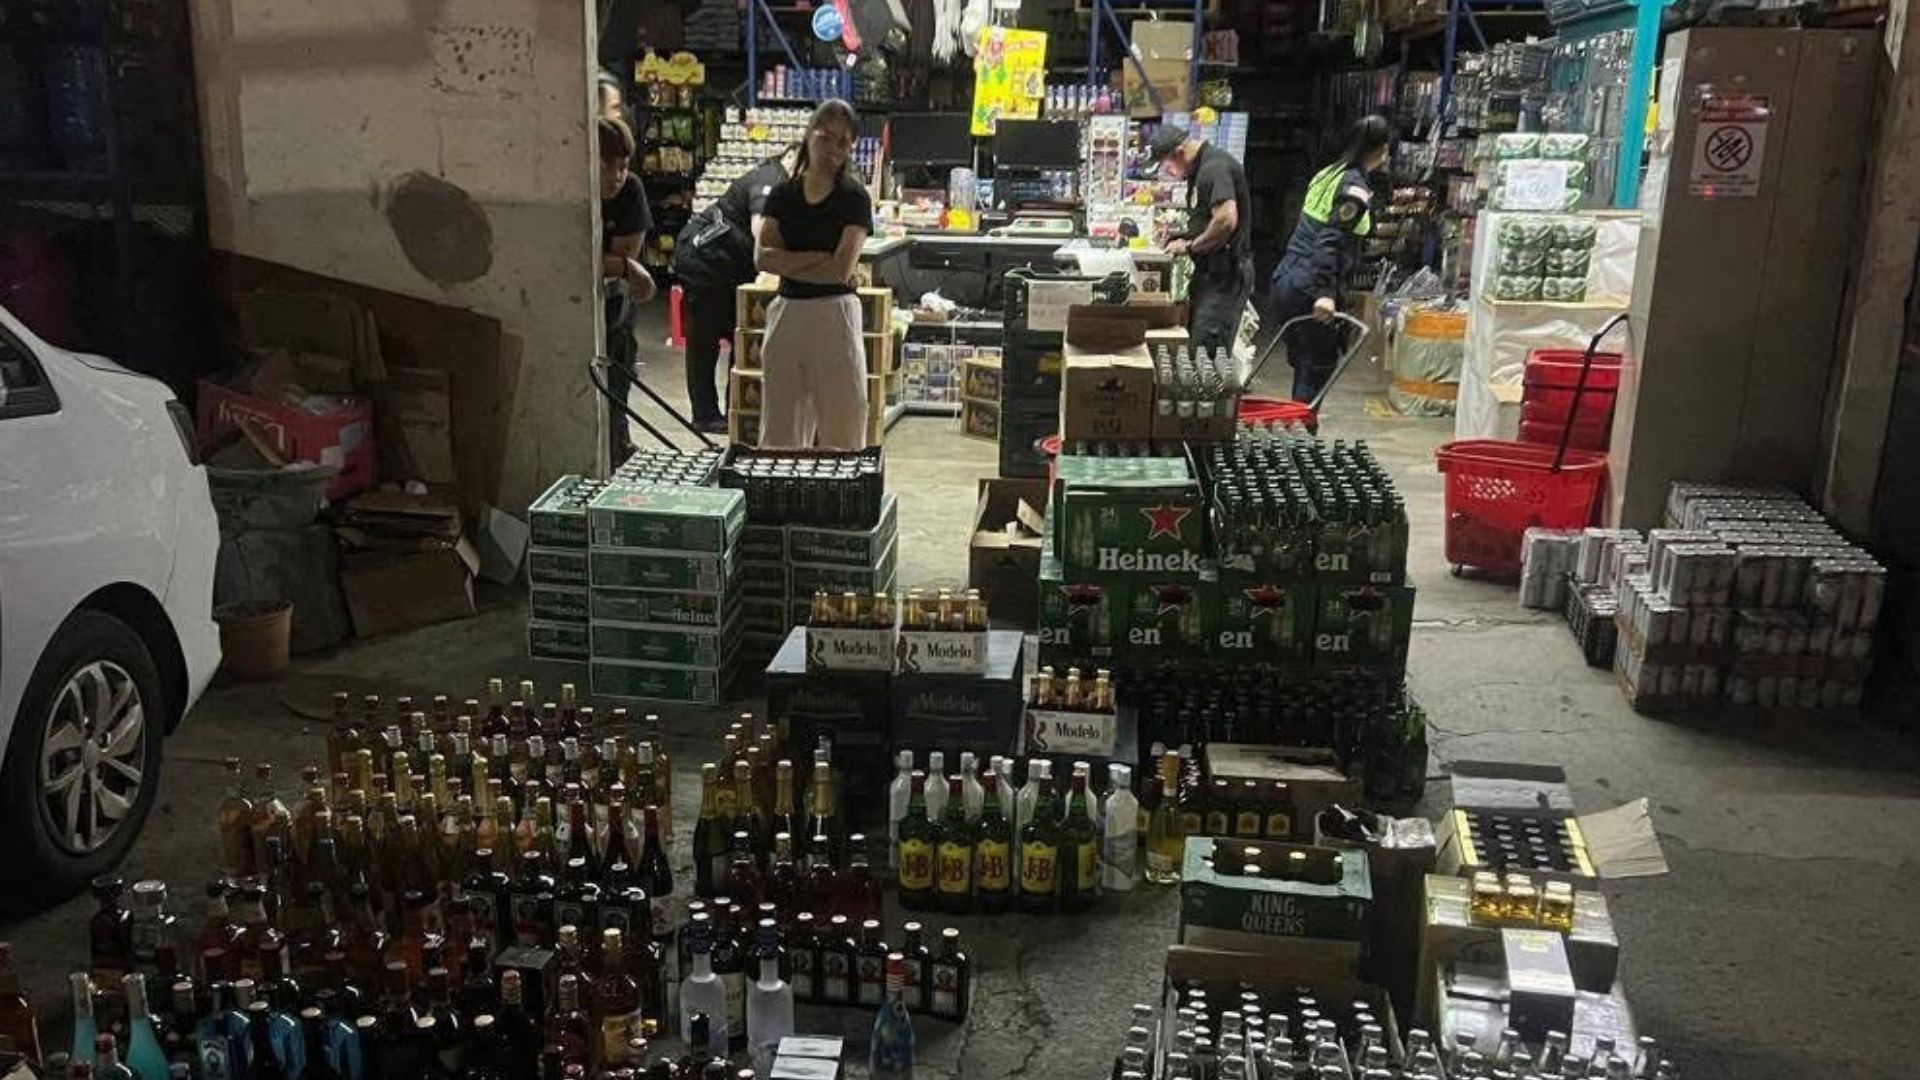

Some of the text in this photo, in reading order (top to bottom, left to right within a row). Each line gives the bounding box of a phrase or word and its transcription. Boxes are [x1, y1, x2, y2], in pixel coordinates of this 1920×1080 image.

[927, 643, 972, 659] Modelo
[1055, 722, 1101, 739] Modelo
[1251, 894, 1296, 916] KING
